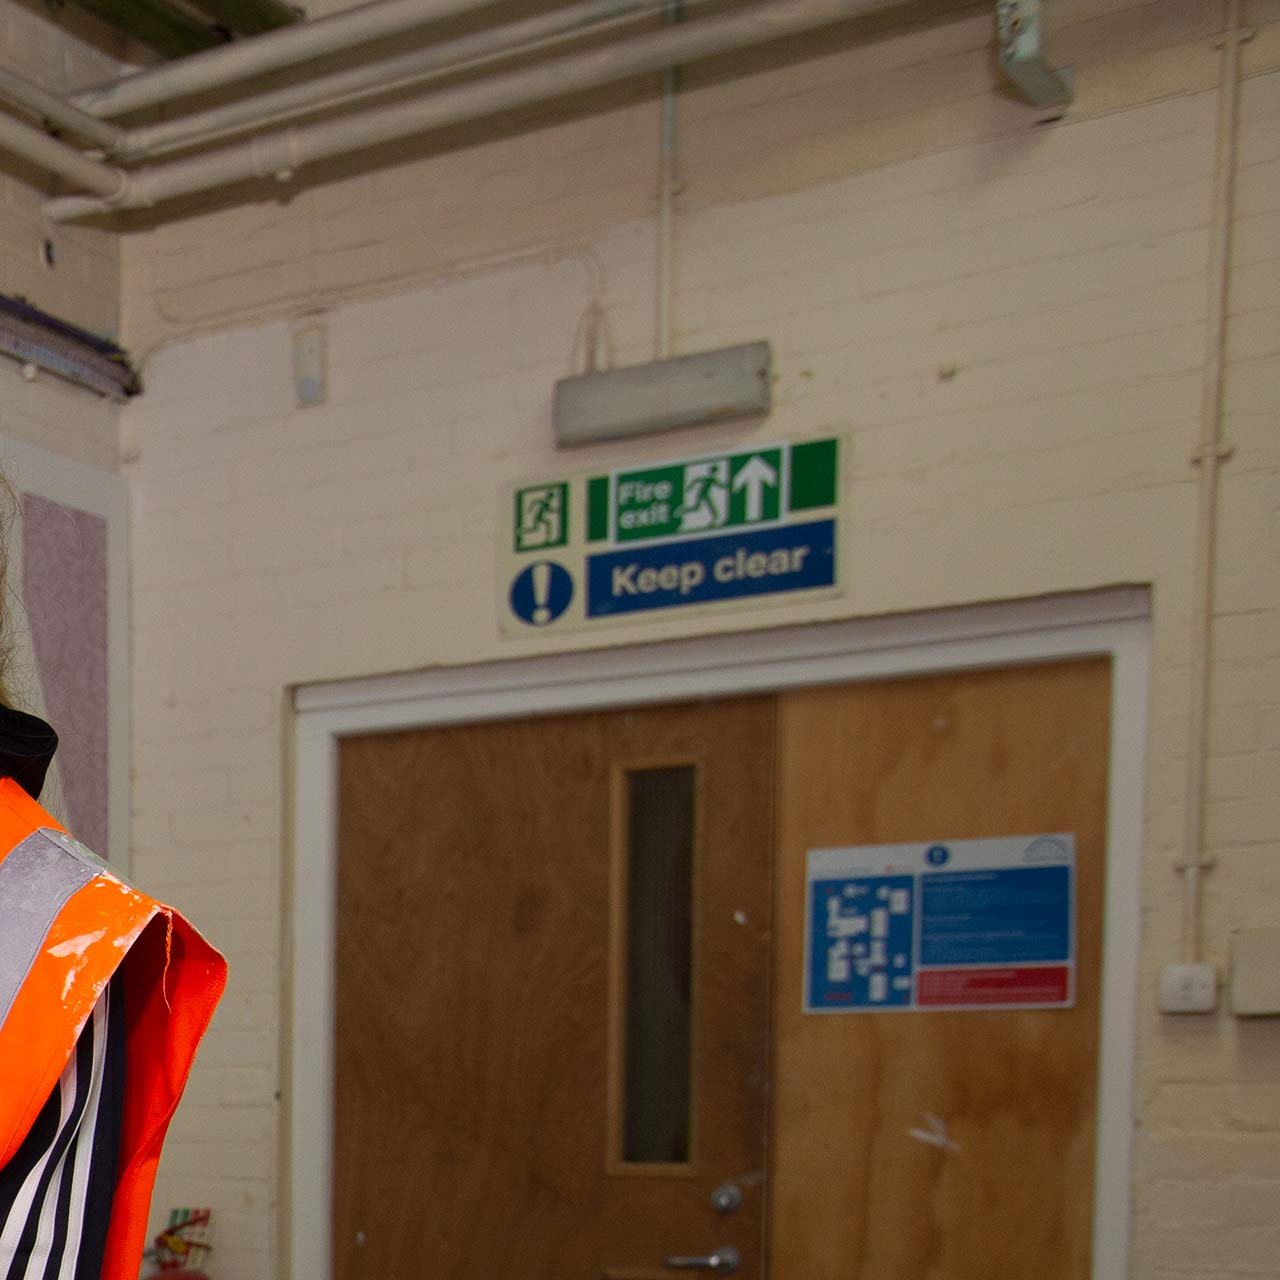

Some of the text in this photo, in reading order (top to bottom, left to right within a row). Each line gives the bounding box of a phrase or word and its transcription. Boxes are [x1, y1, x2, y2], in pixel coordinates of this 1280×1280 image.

[619, 480, 672, 502] Fire
[619, 500, 669, 529] exit
[611, 544, 810, 598] Keep clear
